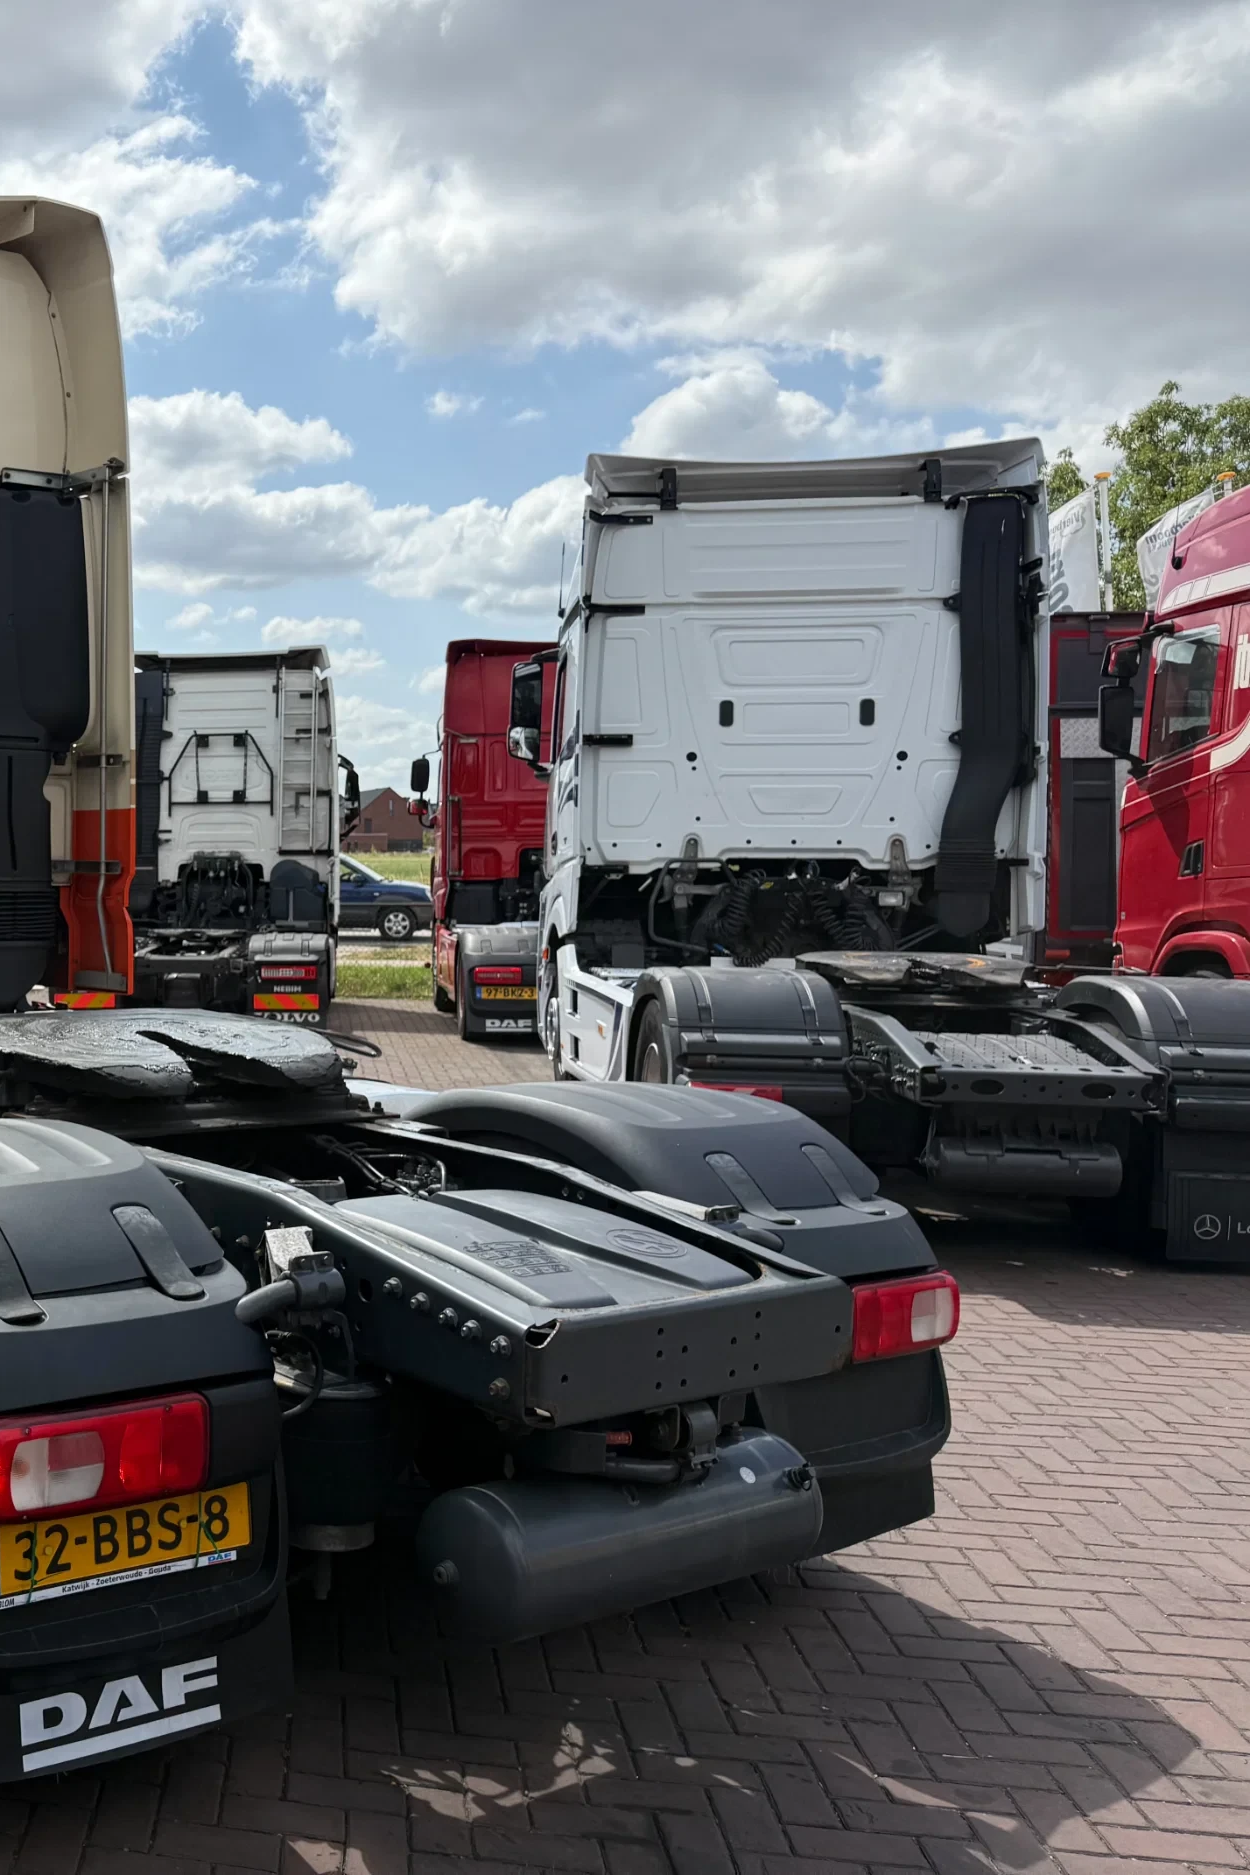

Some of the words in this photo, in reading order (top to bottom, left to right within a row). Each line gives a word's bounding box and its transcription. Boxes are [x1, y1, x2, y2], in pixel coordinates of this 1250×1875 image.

[485, 987, 535, 998] 97-BKZ-3
[254, 1012, 320, 1022] OLVO
[485, 1019, 533, 1028] DAF
[14, 1494, 230, 1581] 32-BBS-8
[207, 1552, 232, 1563] DAF
[62, 1578, 91, 1594] Katwijk
[96, 1569, 144, 1586] Zoeterwoude
[148, 1564, 172, 1576] Gouda
[19, 1655, 218, 1747] DAF
